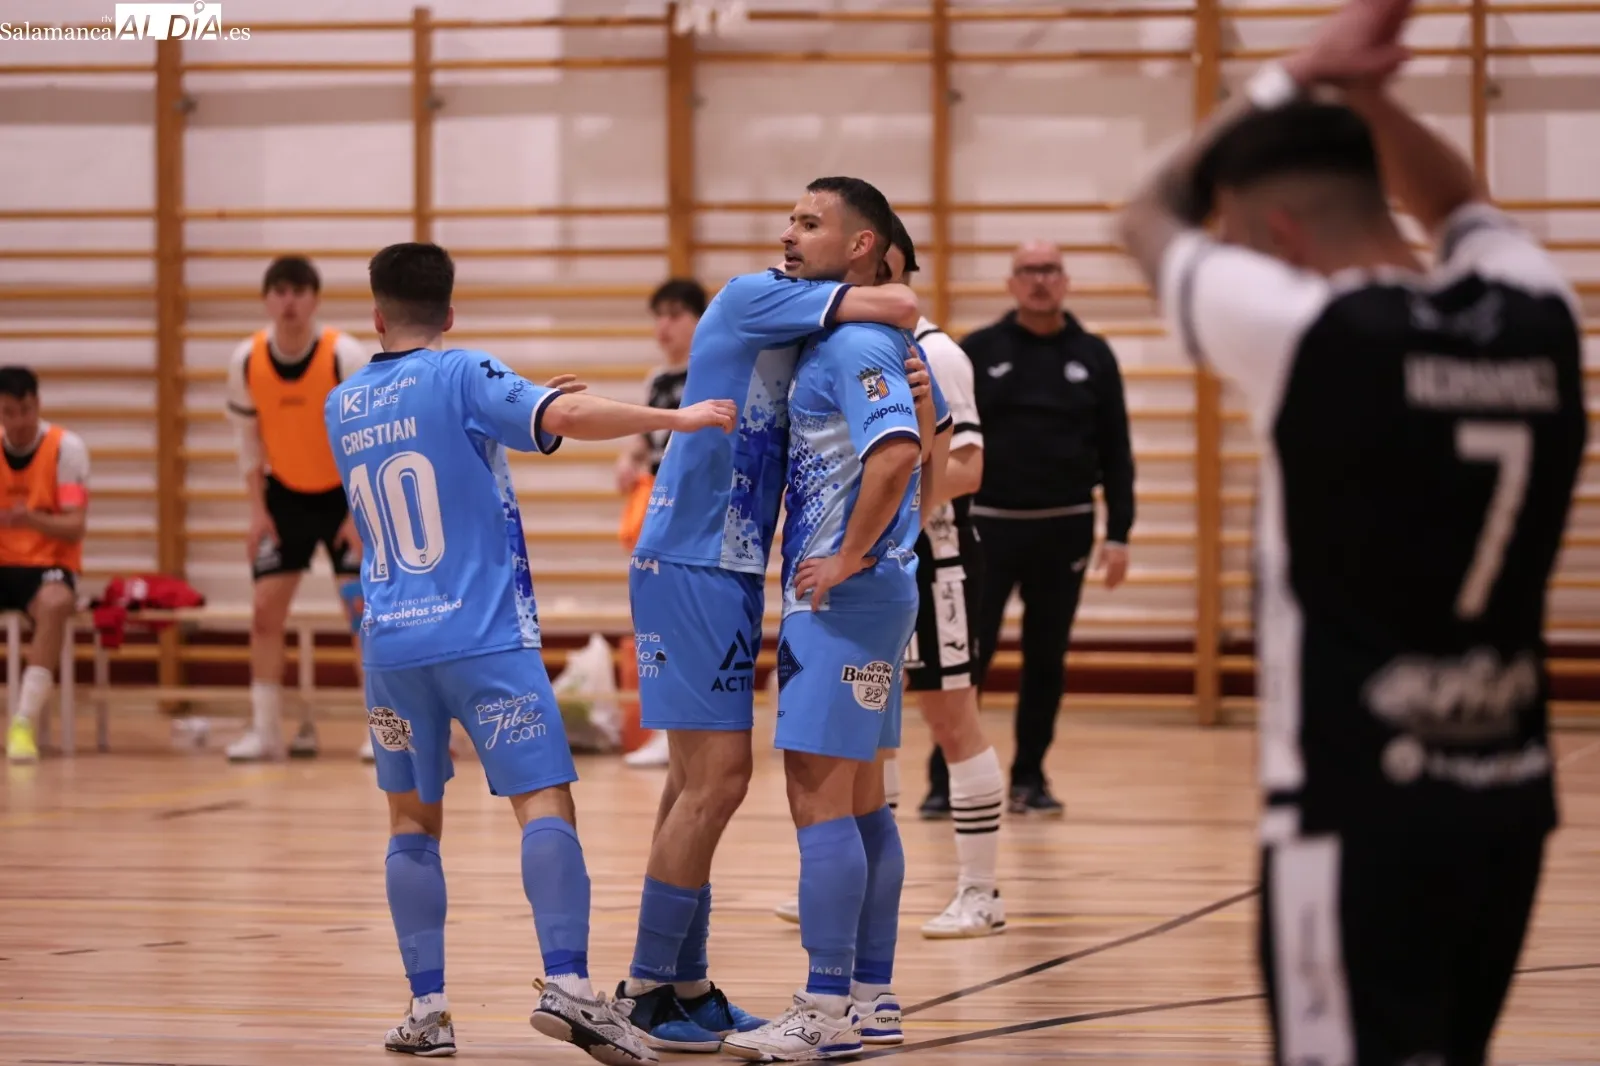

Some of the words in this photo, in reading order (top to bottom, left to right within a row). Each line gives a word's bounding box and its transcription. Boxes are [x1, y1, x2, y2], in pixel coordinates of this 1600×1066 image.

[373, 376, 416, 397] KITCHEN
[372, 394, 399, 409] PLUS
[341, 416, 417, 456] CRISTIAN
[349, 451, 446, 583] 10
[1456, 420, 1534, 618] 7
[377, 608, 430, 622] recoletas
[431, 598, 462, 614] salud
[862, 686, 883, 704] 22
[382, 730, 402, 746] 22
[506, 722, 546, 745] .com
